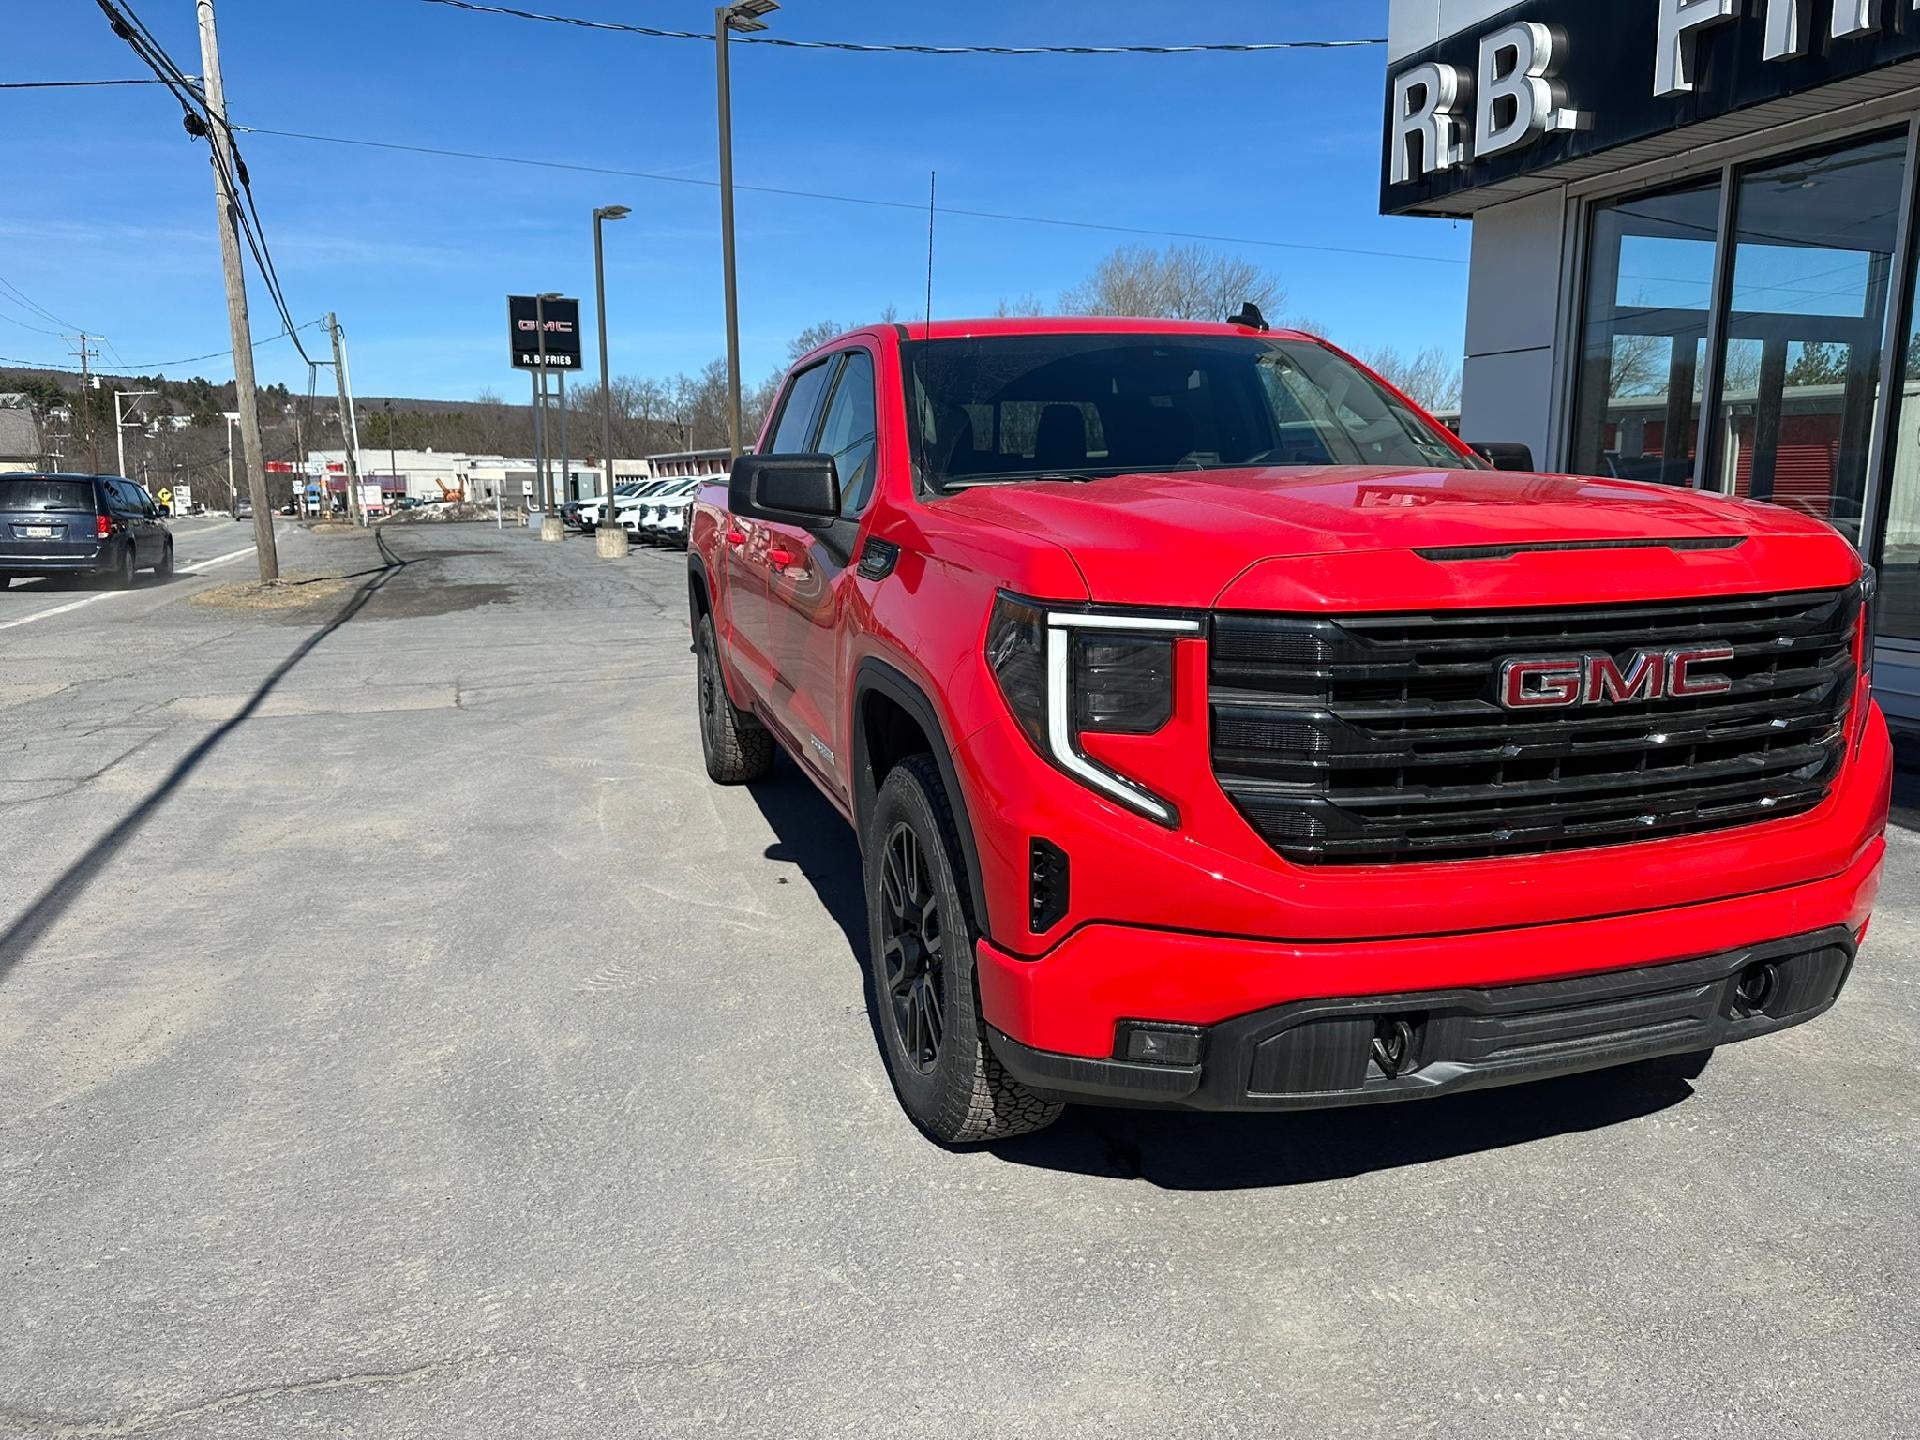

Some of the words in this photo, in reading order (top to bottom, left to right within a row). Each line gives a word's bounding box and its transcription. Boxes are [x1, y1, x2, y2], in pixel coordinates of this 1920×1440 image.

[518, 320, 573, 333] GMC
[545, 355, 572, 366] FRIES
[1499, 645, 1734, 709] GMC
